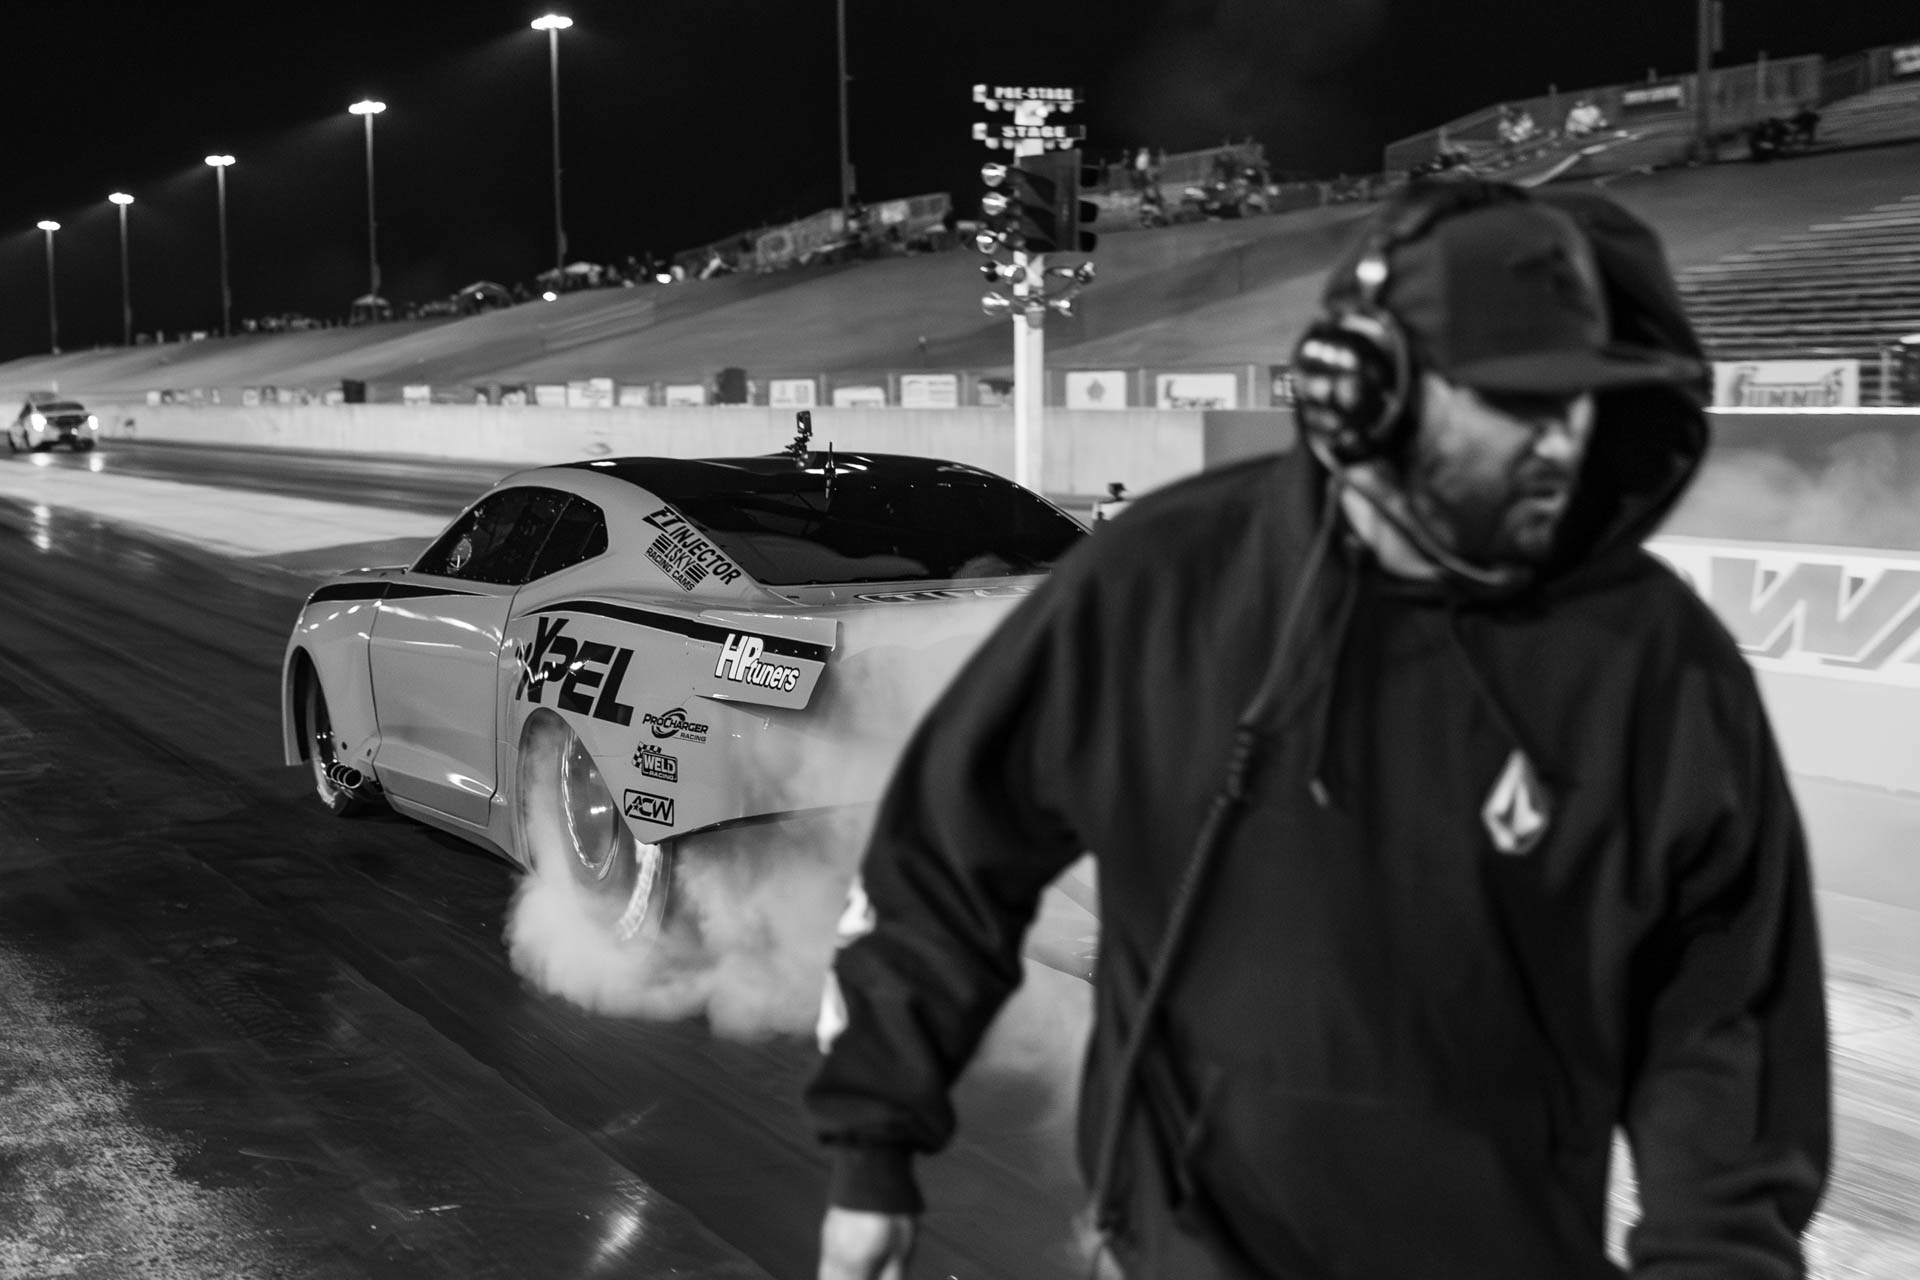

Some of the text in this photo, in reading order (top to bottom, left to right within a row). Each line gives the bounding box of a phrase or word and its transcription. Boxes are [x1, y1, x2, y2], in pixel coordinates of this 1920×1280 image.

[994, 87, 1073, 100] PRE-STAGE
[1002, 126, 1066, 137] STAGE
[664, 544, 697, 571] ISKY
[669, 525, 742, 585] INJECTOR
[645, 547, 695, 591] RACING CAMS
[515, 616, 634, 727] XPEL
[680, 733, 707, 742] RACING
[644, 755, 676, 774] WELD
[649, 770, 674, 780] RACING
